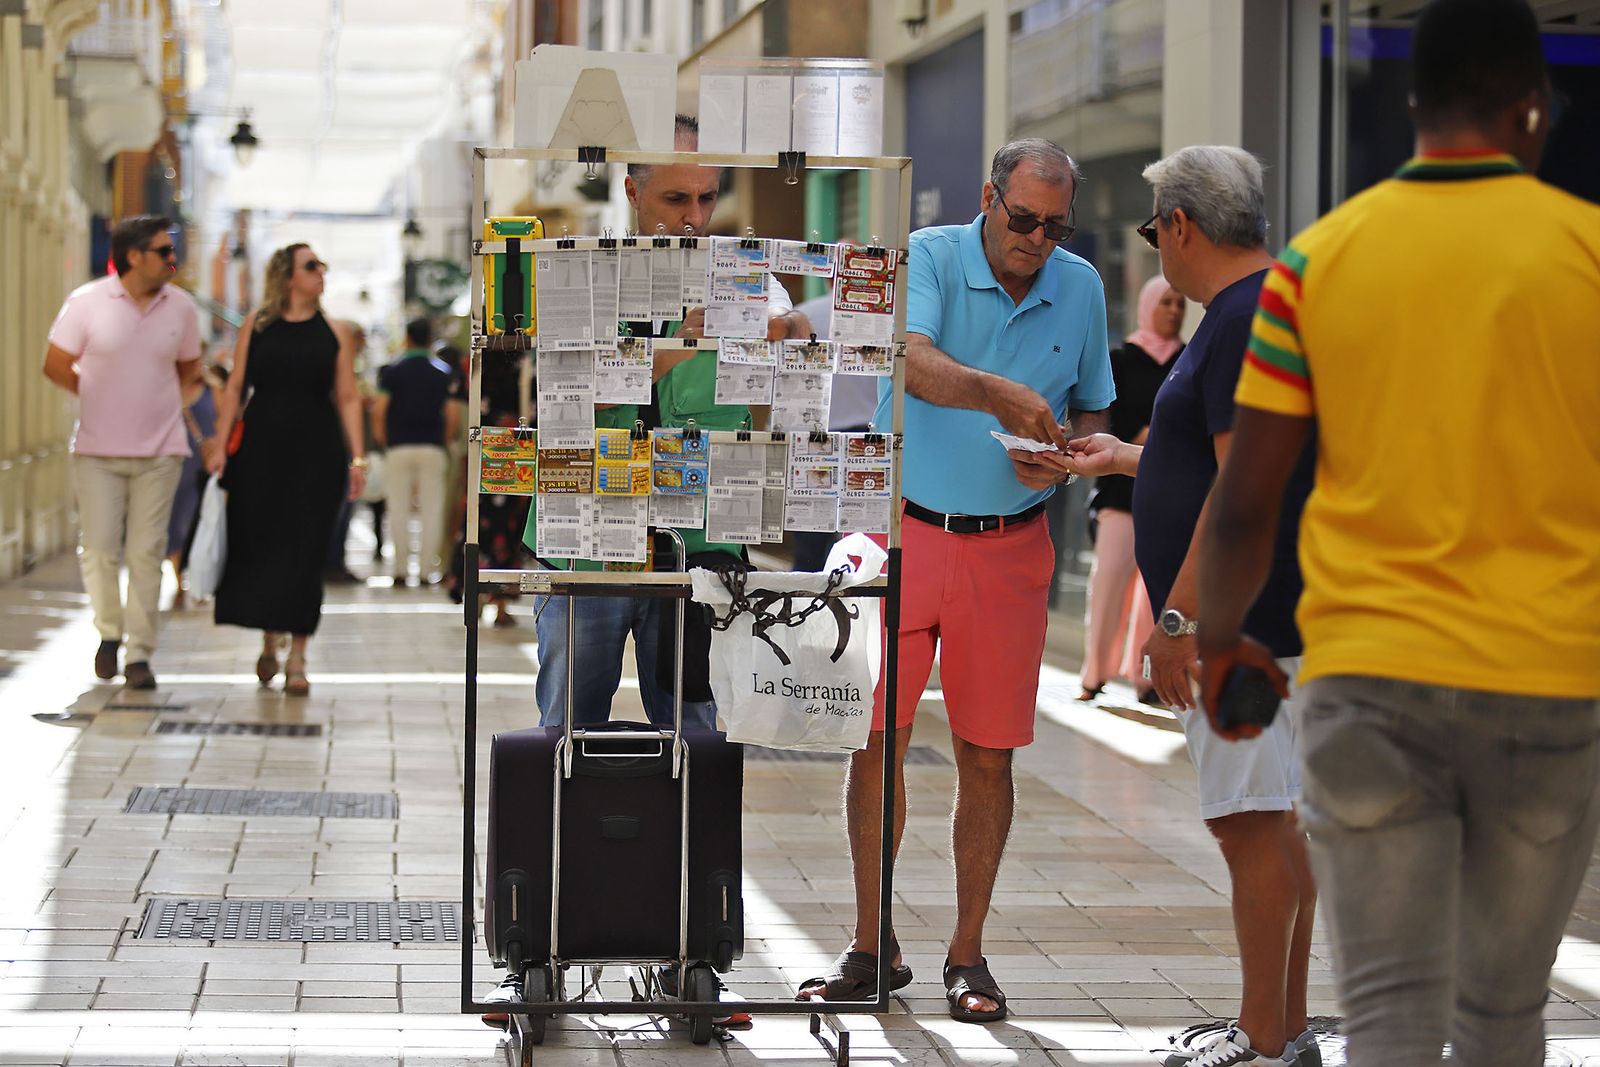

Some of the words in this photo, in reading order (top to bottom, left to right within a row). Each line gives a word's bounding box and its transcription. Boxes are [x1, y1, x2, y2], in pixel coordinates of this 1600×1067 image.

[752, 673, 776, 695] La
[781, 677, 862, 702] Serranía
[805, 703, 821, 714] de
[825, 702, 863, 717] Macías
